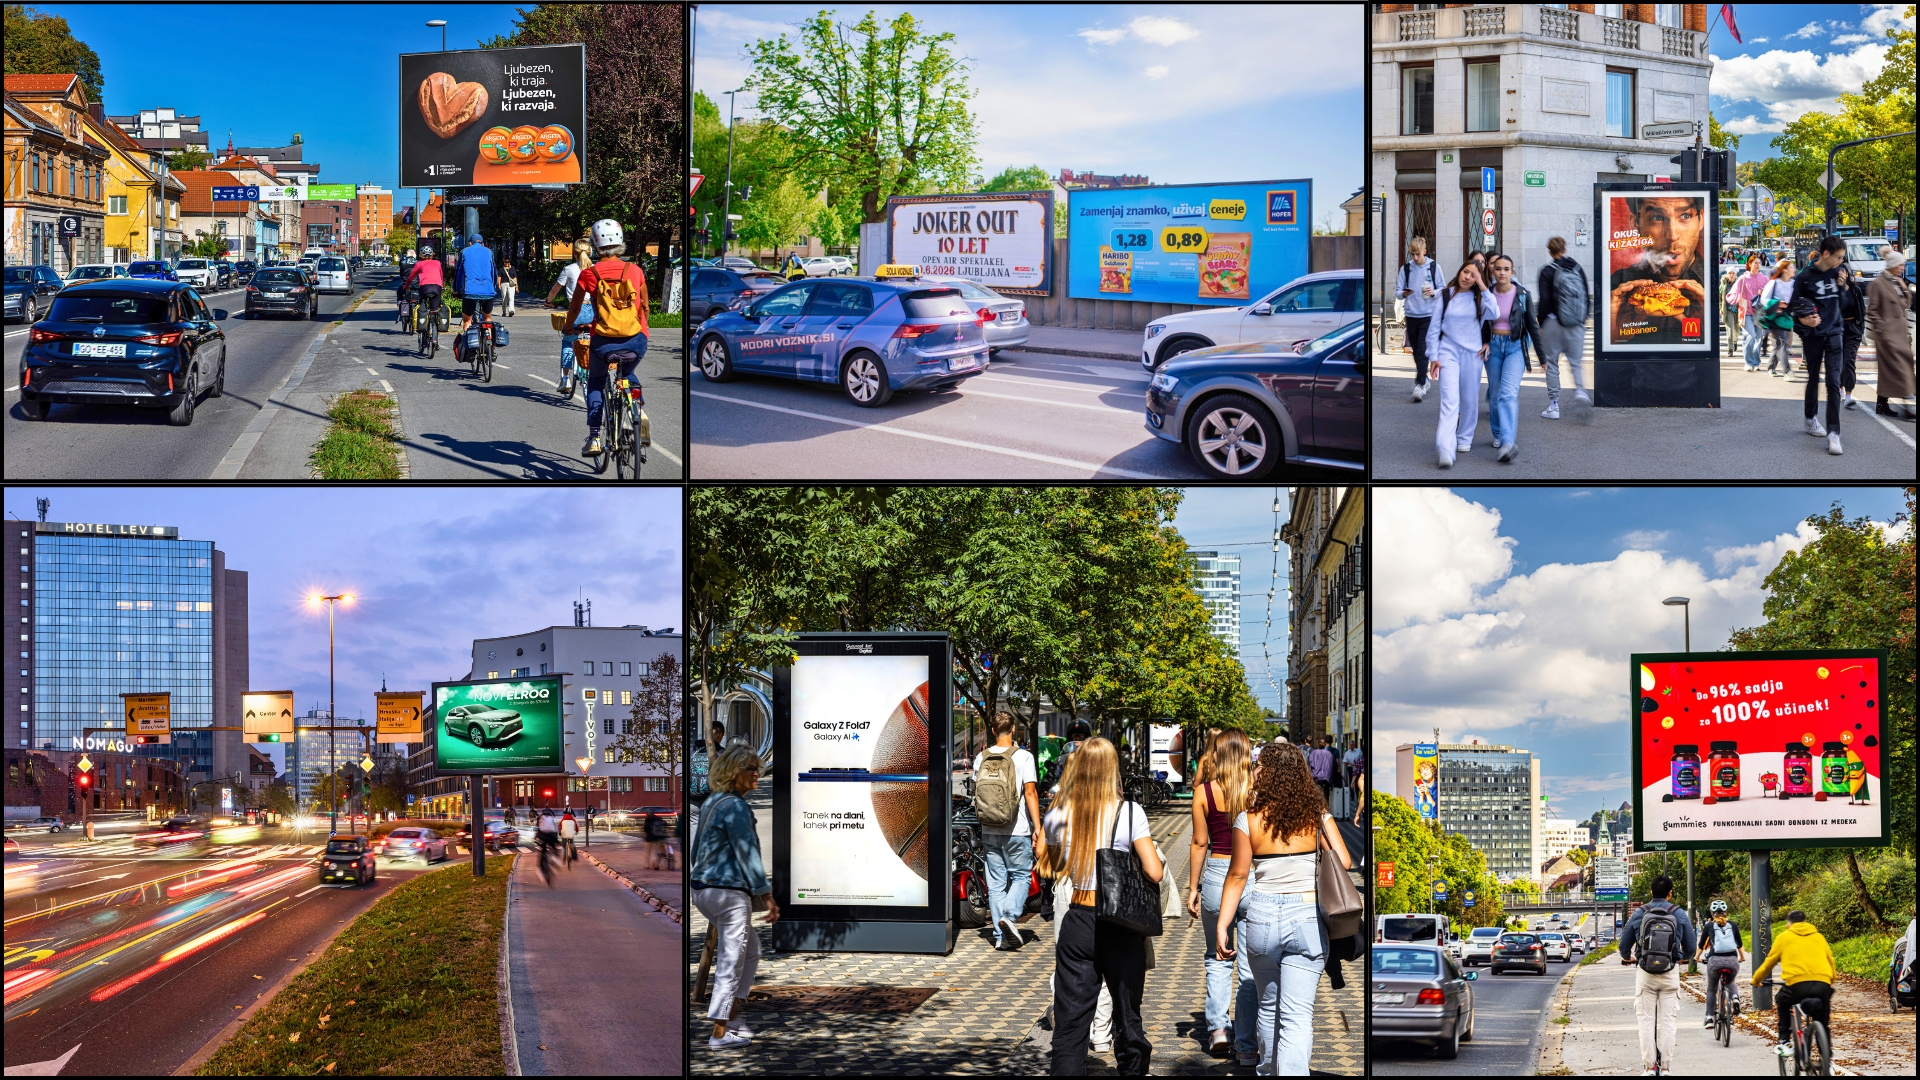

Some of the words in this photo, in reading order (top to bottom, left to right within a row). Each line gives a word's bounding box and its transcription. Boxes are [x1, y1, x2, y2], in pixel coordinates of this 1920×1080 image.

[504, 63, 554, 76] Ljubezen,
[510, 76, 519, 86] ki
[521, 75, 548, 87] traja.
[502, 88, 556, 101] Ljubezen,
[501, 101, 512, 112] ki
[514, 99, 557, 112] razvaja.
[1080, 206, 1124, 218] Zamenjaj
[1126, 205, 1170, 217] znamko,
[1172, 203, 1206, 217] uživaj
[1210, 204, 1245, 216] ceneje
[912, 210, 972, 234] JOKER
[976, 210, 1019, 234] OUT
[1613, 229, 1640, 239] OKUS,
[937, 236, 955, 254] 10
[959, 237, 990, 254] LET
[1116, 234, 1147, 249] 1,28
[1166, 233, 1202, 249] 0,89
[1609, 241, 1619, 249] KI
[1620, 237, 1654, 248] ZAŽIGA
[922, 255, 941, 264] OPEN
[943, 256, 957, 265] AIR
[959, 257, 1005, 266] SPEKTAKEL
[1102, 252, 1129, 260] HARIBO
[1207, 259, 1239, 269] BEARS
[957, 265, 1011, 278] LJUBLJANA
[1619, 326, 1658, 336] Habanero
[740, 340, 774, 350] MODRI
[775, 333, 835, 347] VOZNIK.SI
[65, 522, 113, 534] HOTEL
[120, 525, 148, 535] LEV
[473, 691, 504, 703] NOVI
[506, 688, 550, 701] ELROQ
[1696, 692, 1708, 701] Do
[1709, 683, 1741, 699] 96%
[1744, 679, 1784, 695] sadja
[1699, 718, 1711, 726] za
[1711, 699, 1771, 724] 100%
[1775, 698, 1830, 716] učinek!
[586, 703, 596, 758] TIVOLI
[803, 721, 838, 732] Galaxy
[838, 721, 845, 730] Z
[845, 721, 871, 730] Fold7
[813, 733, 842, 742] Galaxy
[72, 736, 134, 753] NOMAGO
[802, 811, 830, 819] Tanek
[843, 811, 866, 820] dlani,
[803, 821, 829, 829] lahek
[829, 821, 841, 831] pri
[842, 821, 865, 829] metu
[1765, 819, 1785, 827] SADNI
[1830, 818, 1858, 826] MEDEXA
